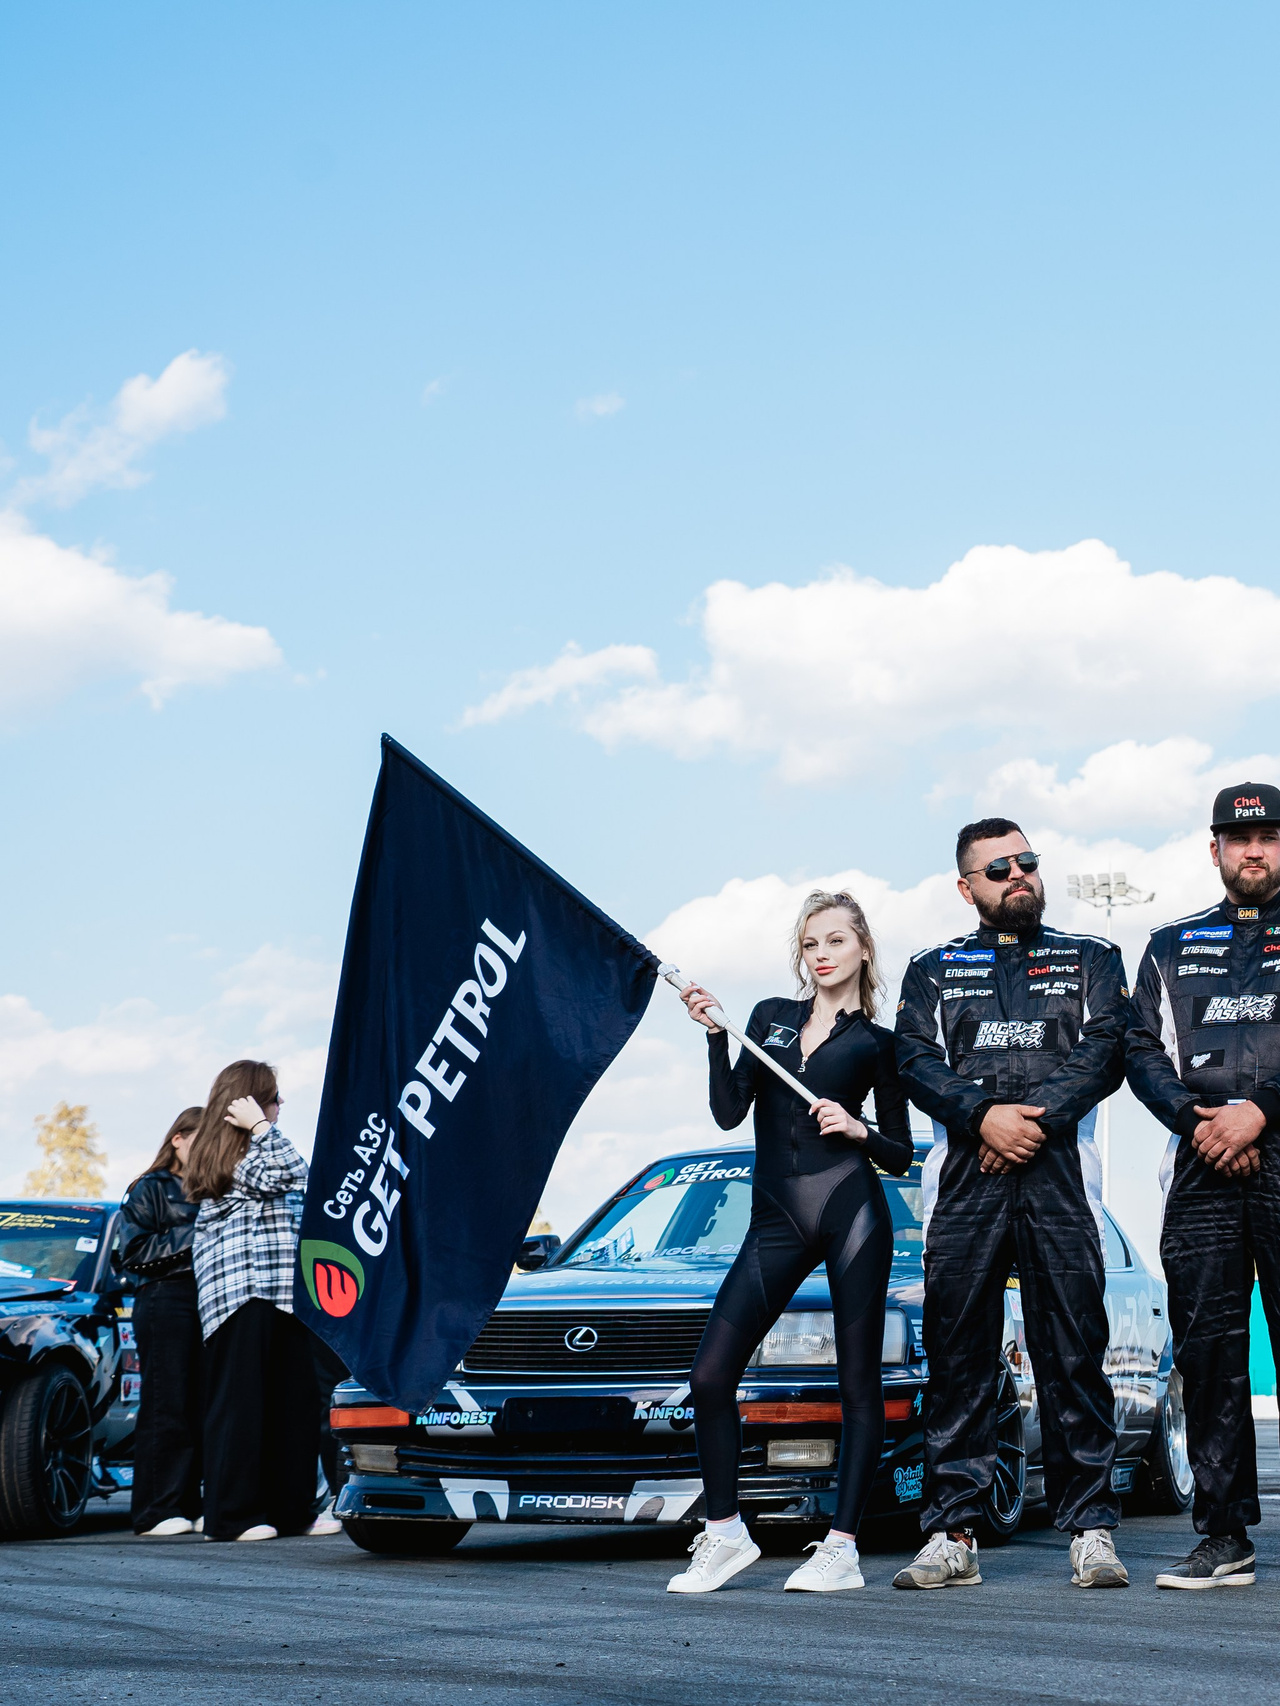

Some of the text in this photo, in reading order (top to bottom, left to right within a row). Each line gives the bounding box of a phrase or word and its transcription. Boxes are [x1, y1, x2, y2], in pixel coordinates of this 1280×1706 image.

[1233, 796, 1261, 807] Chel
[1235, 807, 1266, 818] Parts
[1239, 909, 1257, 918] OMP
[1029, 982, 1050, 991] FAN
[1044, 988, 1066, 996] PRO
[1208, 995, 1246, 1010] RACE
[1202, 1008, 1239, 1024] BASE
[979, 1020, 1017, 1035] RACE
[973, 1034, 1010, 1049] BASE
[353, 918, 527, 1257] GET PETROL
[323, 1112, 387, 1219] Сеть АЗС
[679, 1160, 723, 1175] GET
[671, 1166, 751, 1185] PETROL
